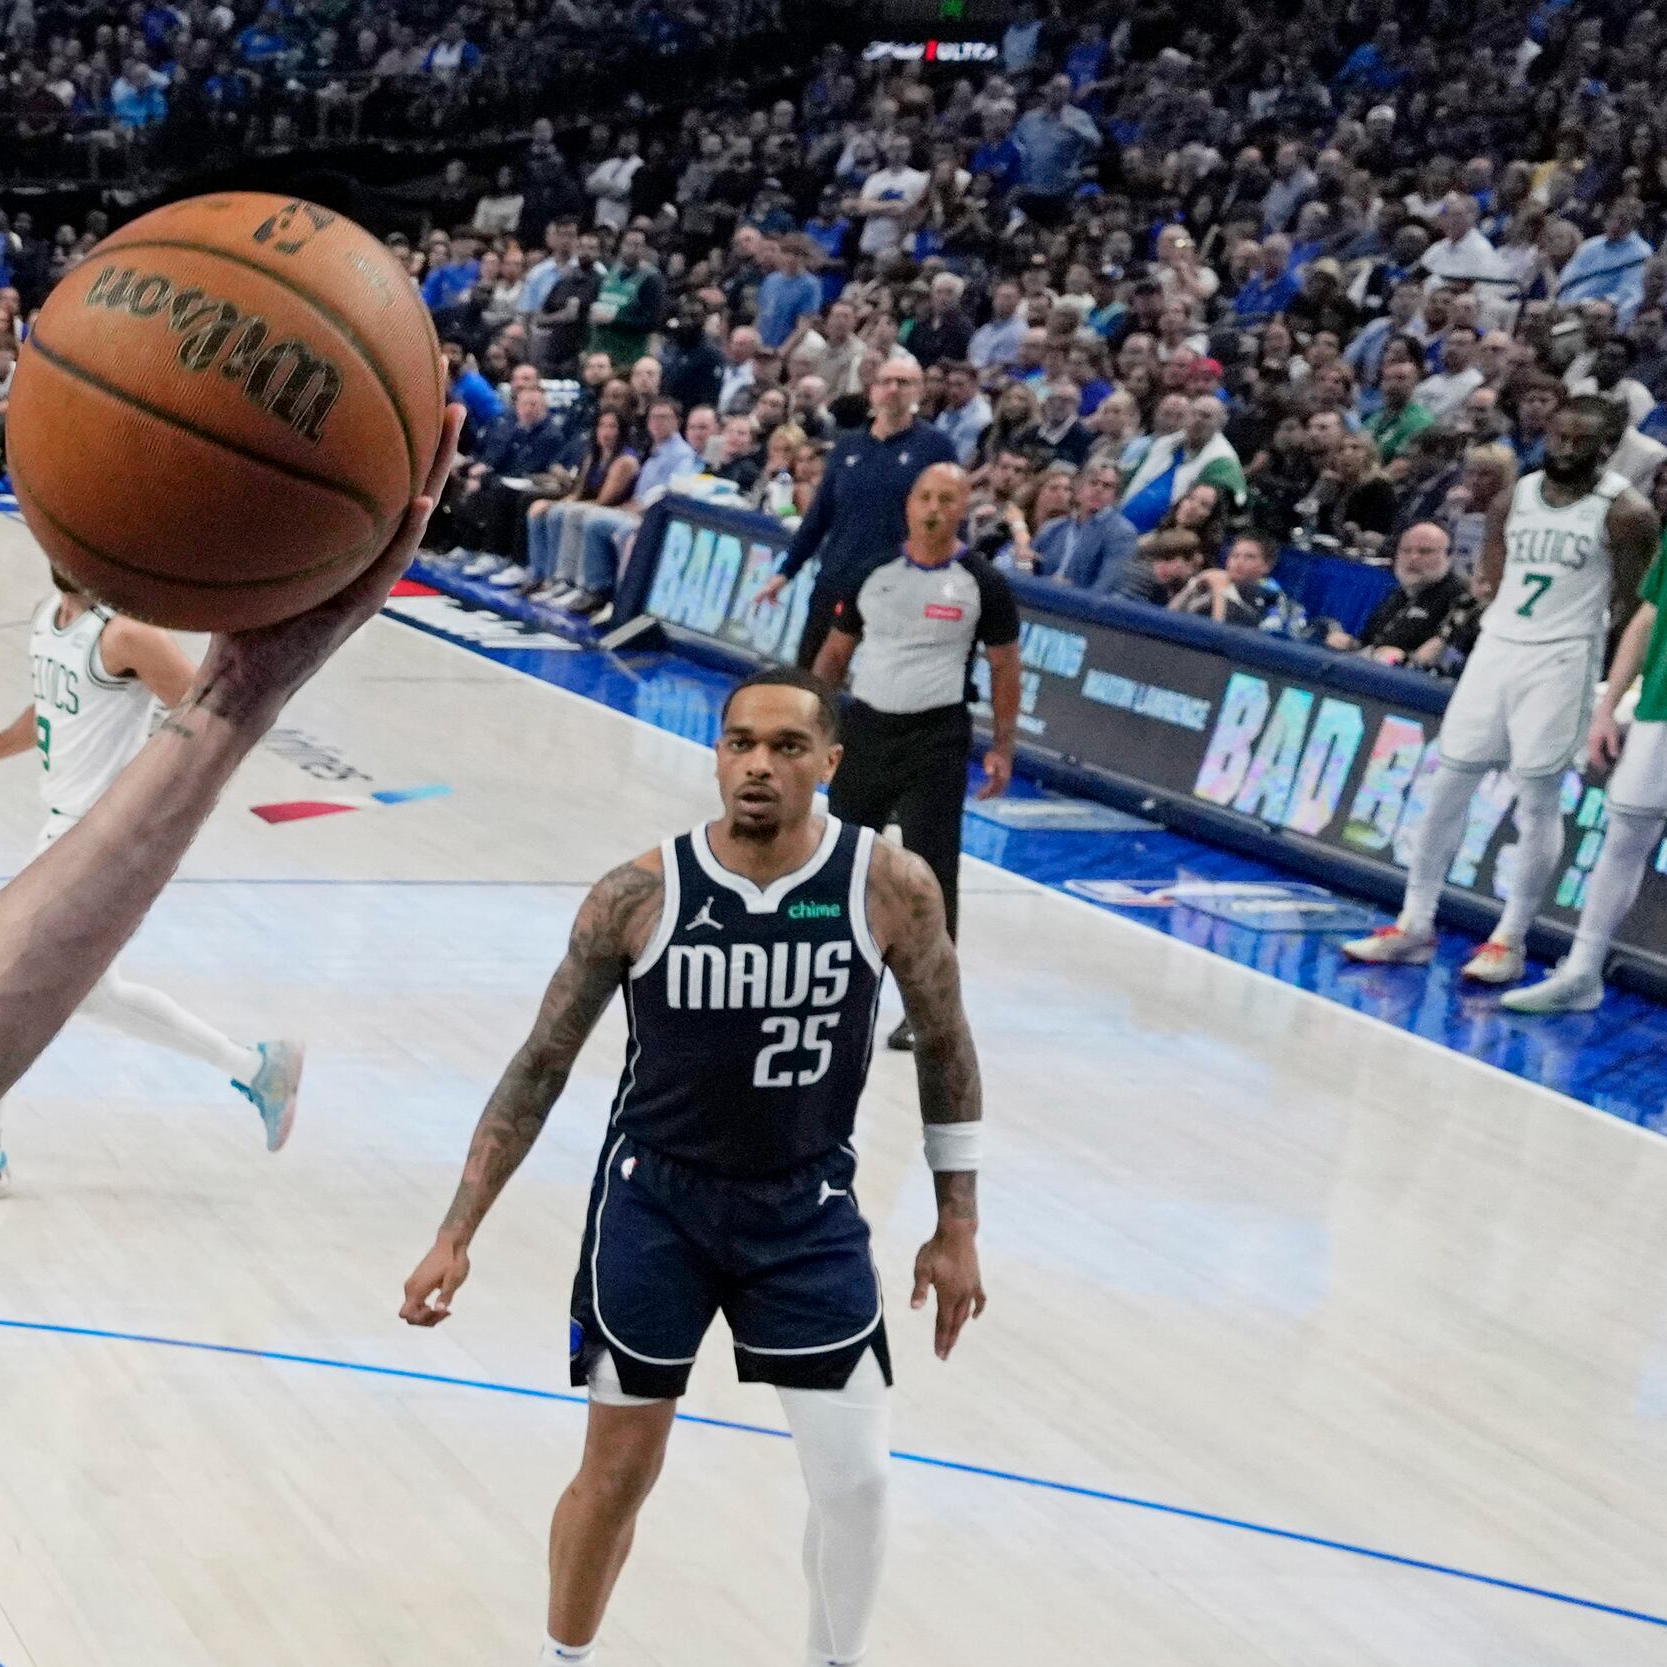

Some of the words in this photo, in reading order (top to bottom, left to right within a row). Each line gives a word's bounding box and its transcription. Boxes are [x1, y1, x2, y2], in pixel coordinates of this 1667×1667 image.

[84, 265, 343, 445] Wilson
[647, 520, 742, 635] BAD
[1516, 573, 1554, 617] 7
[1193, 672, 1364, 837] BAD
[787, 900, 842, 919] chime
[666, 940, 852, 1010] MAVS
[753, 1012, 841, 1088] 25
